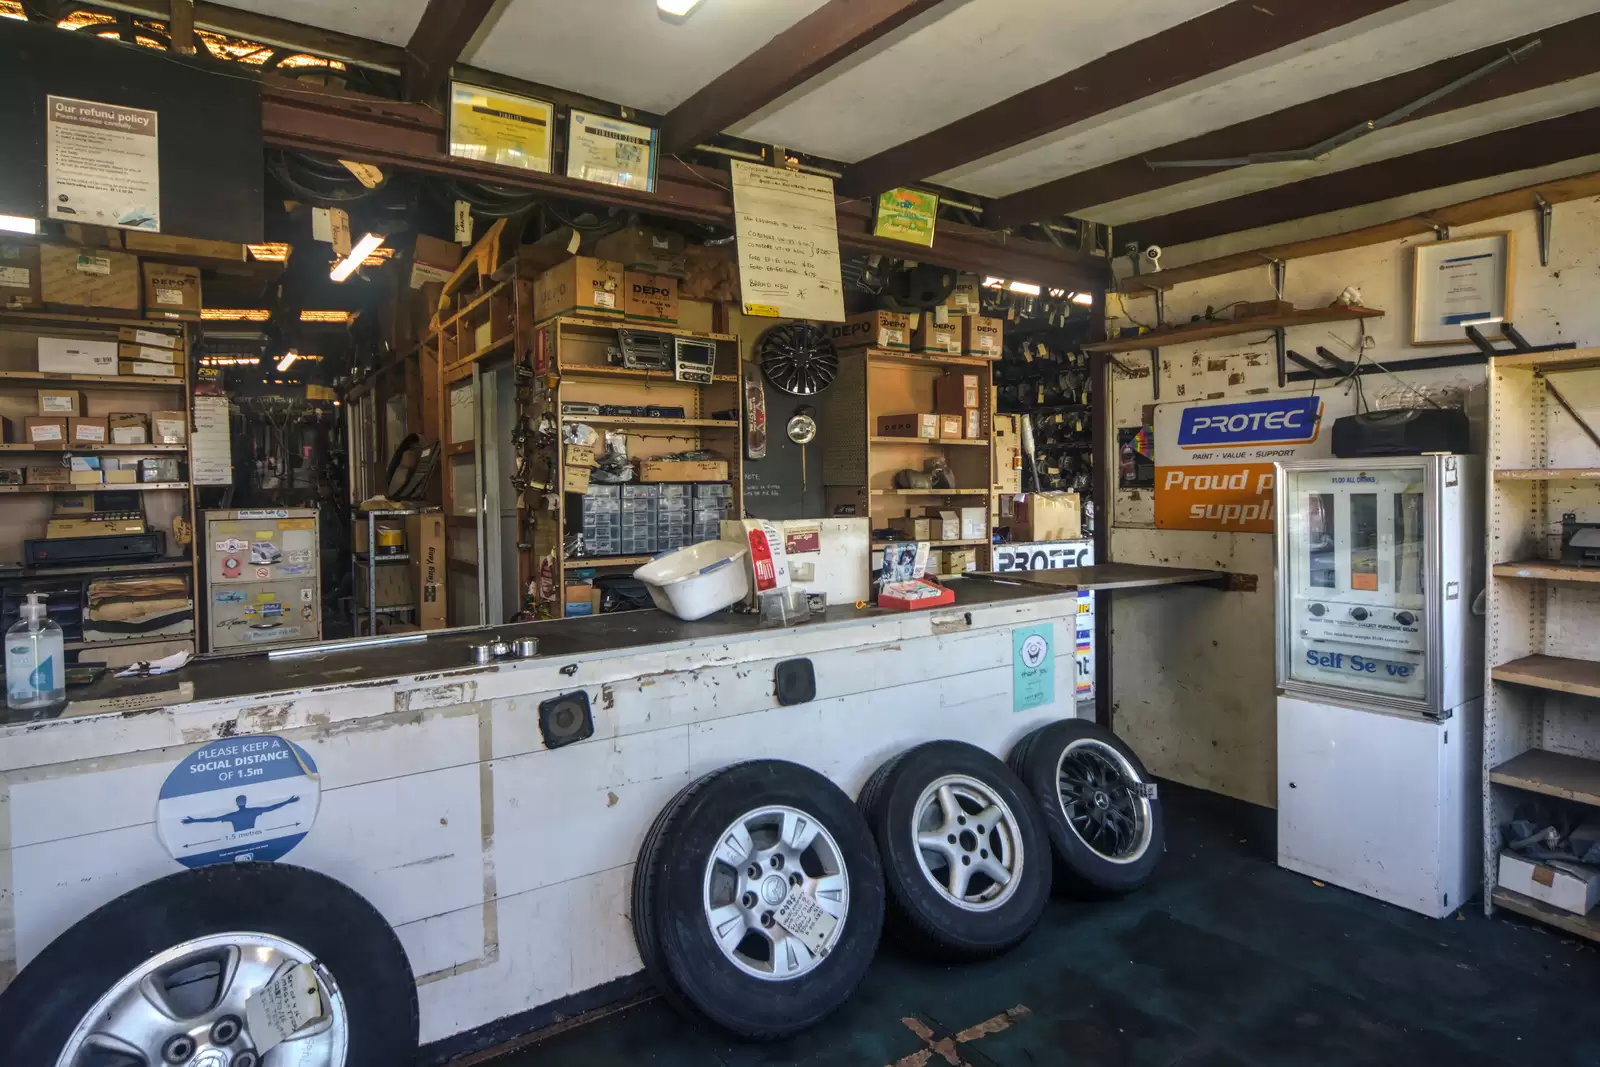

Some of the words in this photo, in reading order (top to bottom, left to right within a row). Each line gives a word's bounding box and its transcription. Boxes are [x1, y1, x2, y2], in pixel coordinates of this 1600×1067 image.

[56, 103, 76, 113] Our
[80, 107, 115, 119] refund
[118, 113, 149, 126] policy
[633, 284, 670, 296] DEPO
[832, 322, 871, 338] DEPO
[883, 319, 906, 328] DEPO
[1191, 409, 1304, 435] PROTEC
[1255, 450, 1295, 458] SUPPORT
[1164, 470, 1253, 491] Proud
[999, 548, 1088, 572] PROTEC
[1306, 650, 1342, 669] Self
[1021, 669, 1037, 678] thank
[198, 746, 238, 760] PLEASE
[242, 742, 269, 752] KEEP
[272, 740, 280, 749] A
[190, 760, 232, 774] SOCIAL
[235, 750, 289, 766] DISTANCE
[218, 771, 234, 781] OF
[238, 768, 263, 778] 1.5m
[238, 829, 262, 839] metres
